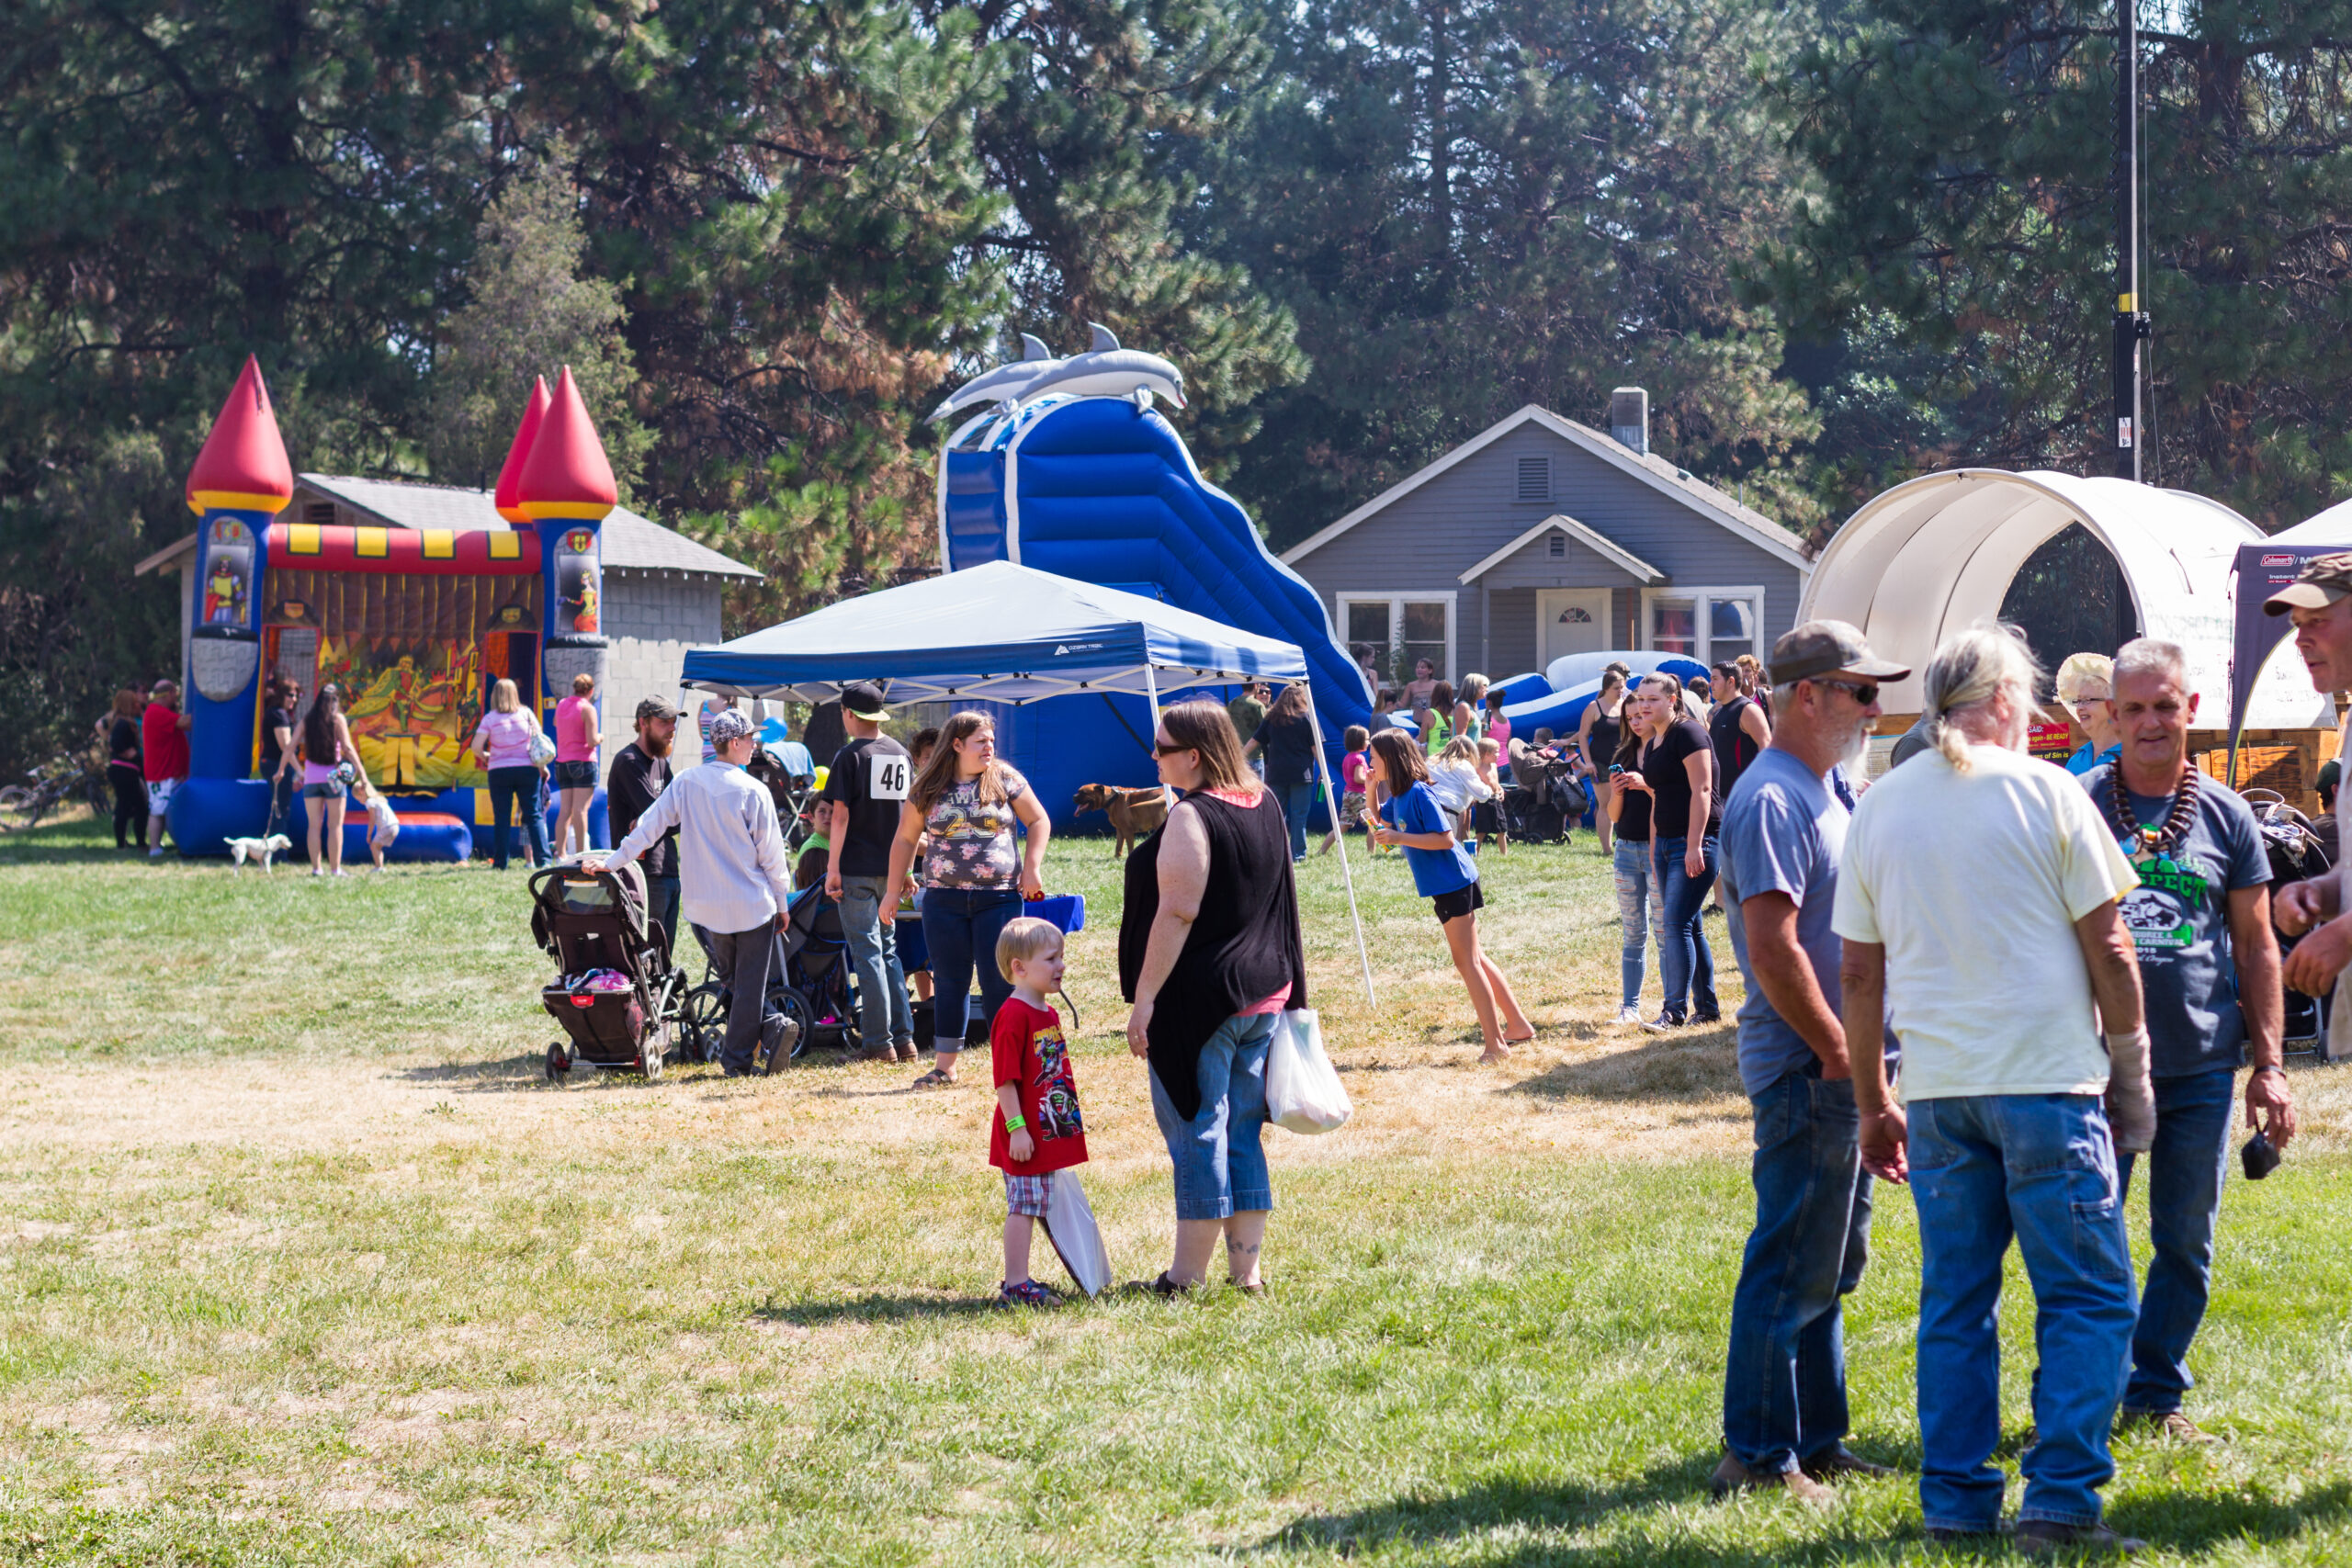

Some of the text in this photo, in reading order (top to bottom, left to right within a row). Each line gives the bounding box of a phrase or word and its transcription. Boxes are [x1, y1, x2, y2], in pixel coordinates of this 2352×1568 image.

[2264, 556, 2288, 564] Coleman
[881, 763, 904, 791] 46
[937, 806, 1000, 840] 23
[2139, 939, 2185, 947] CARNIVAL
